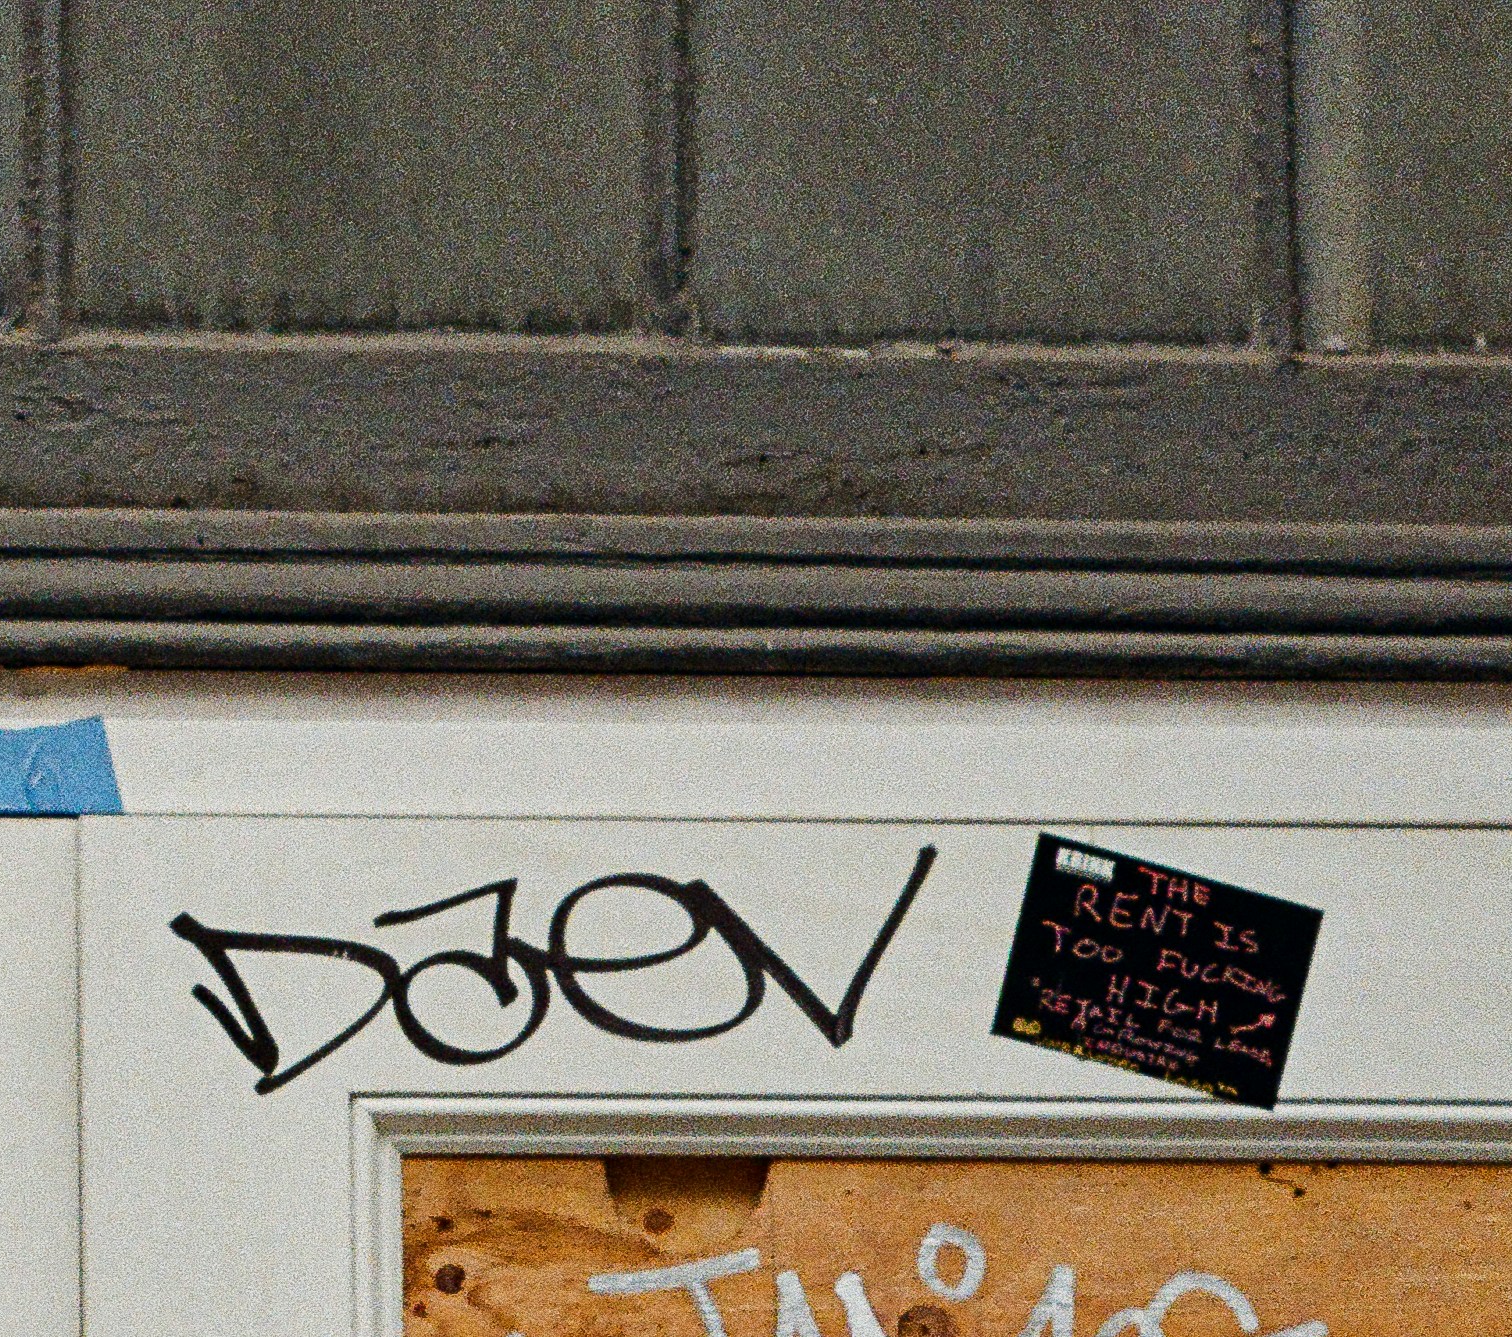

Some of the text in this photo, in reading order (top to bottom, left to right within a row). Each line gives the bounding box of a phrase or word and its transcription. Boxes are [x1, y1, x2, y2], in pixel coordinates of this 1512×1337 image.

[1138, 864, 1211, 905] THE
[1074, 883, 1260, 953] RENT IS
[1041, 918, 1288, 1004] TOO FUCKING
[1105, 974, 1219, 1024] HIGH
